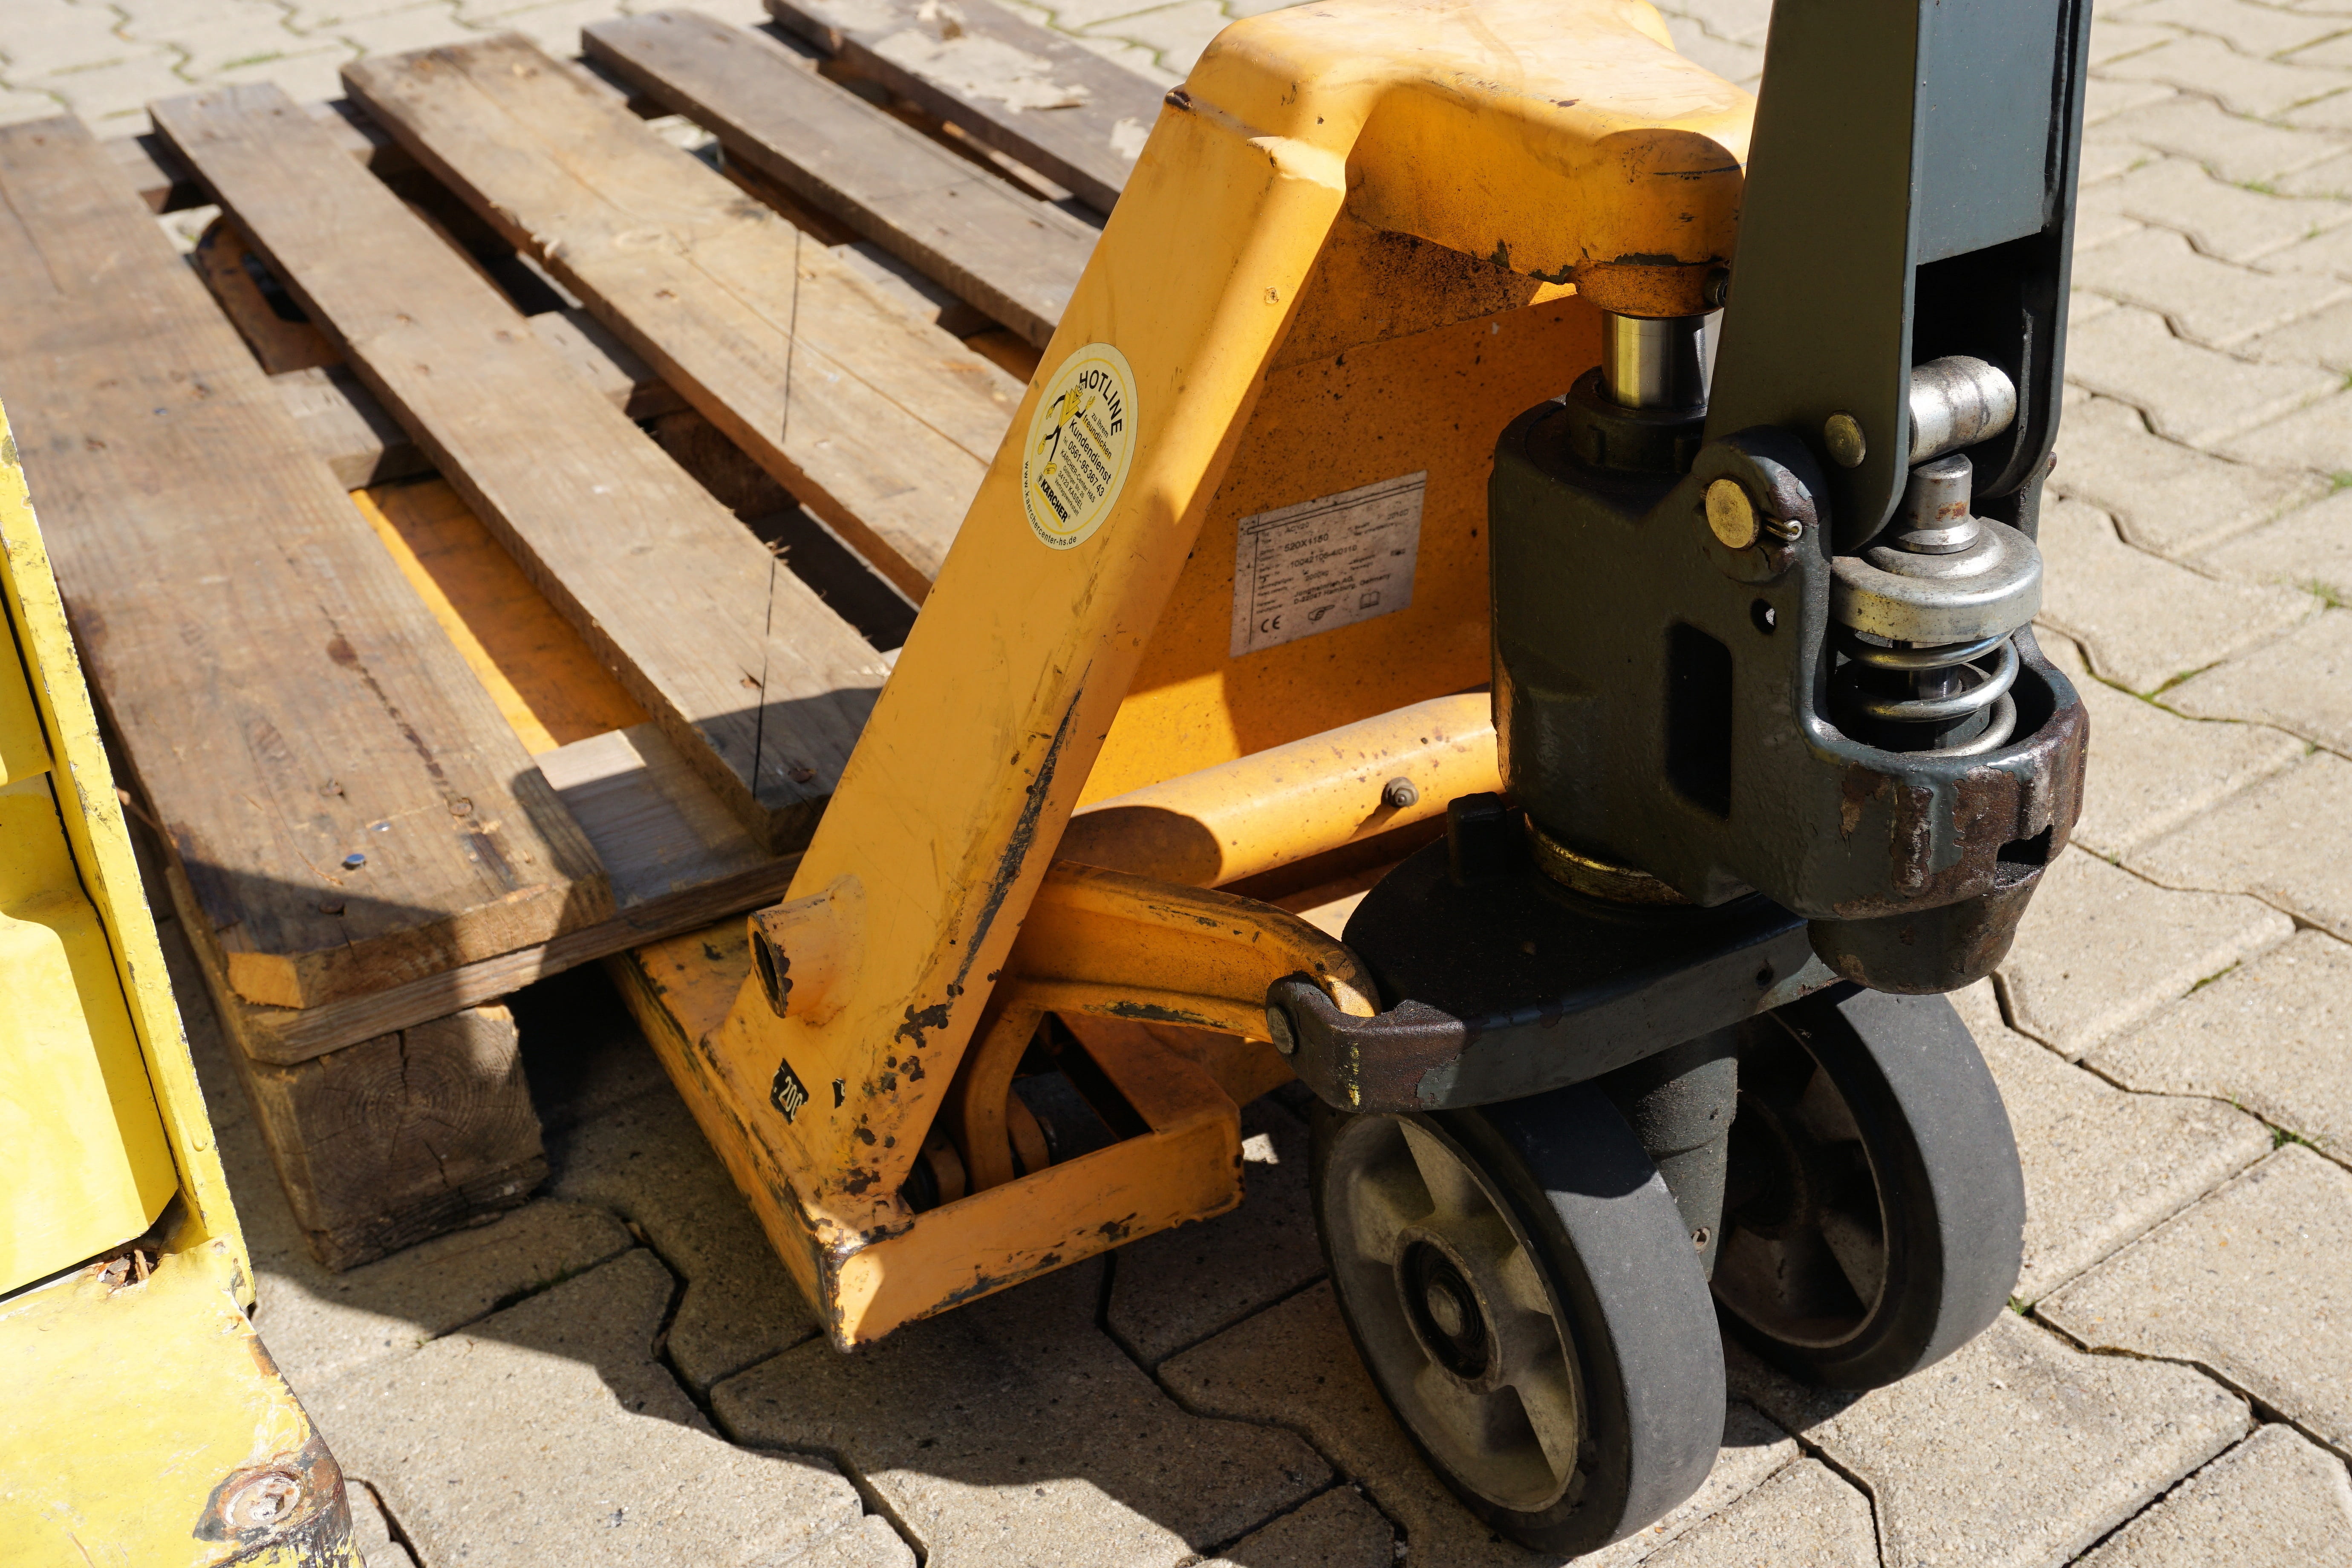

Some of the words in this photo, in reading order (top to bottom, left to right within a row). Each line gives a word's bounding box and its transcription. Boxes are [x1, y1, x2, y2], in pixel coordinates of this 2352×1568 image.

[1079, 370, 1122, 436] HOTLINE
[1083, 414, 1111, 459] freundlichen
[1092, 413, 1097, 422] zu
[1097, 419, 1108, 438] Ihrem
[1069, 419, 1111, 484] Kundendienst
[1058, 471, 1069, 488] 34123
[1068, 486, 1082, 510] KASSEL
[1061, 449, 1088, 491] KÄRCHER-Center
[1087, 489, 1095, 502] H&S
[1063, 465, 1075, 485] Göttinger
[1024, 461, 1076, 545] www.kaerchercenter-hs.de
[1055, 478, 1079, 516] Vertragswerkstatt
[1261, 615, 1281, 633] CE
